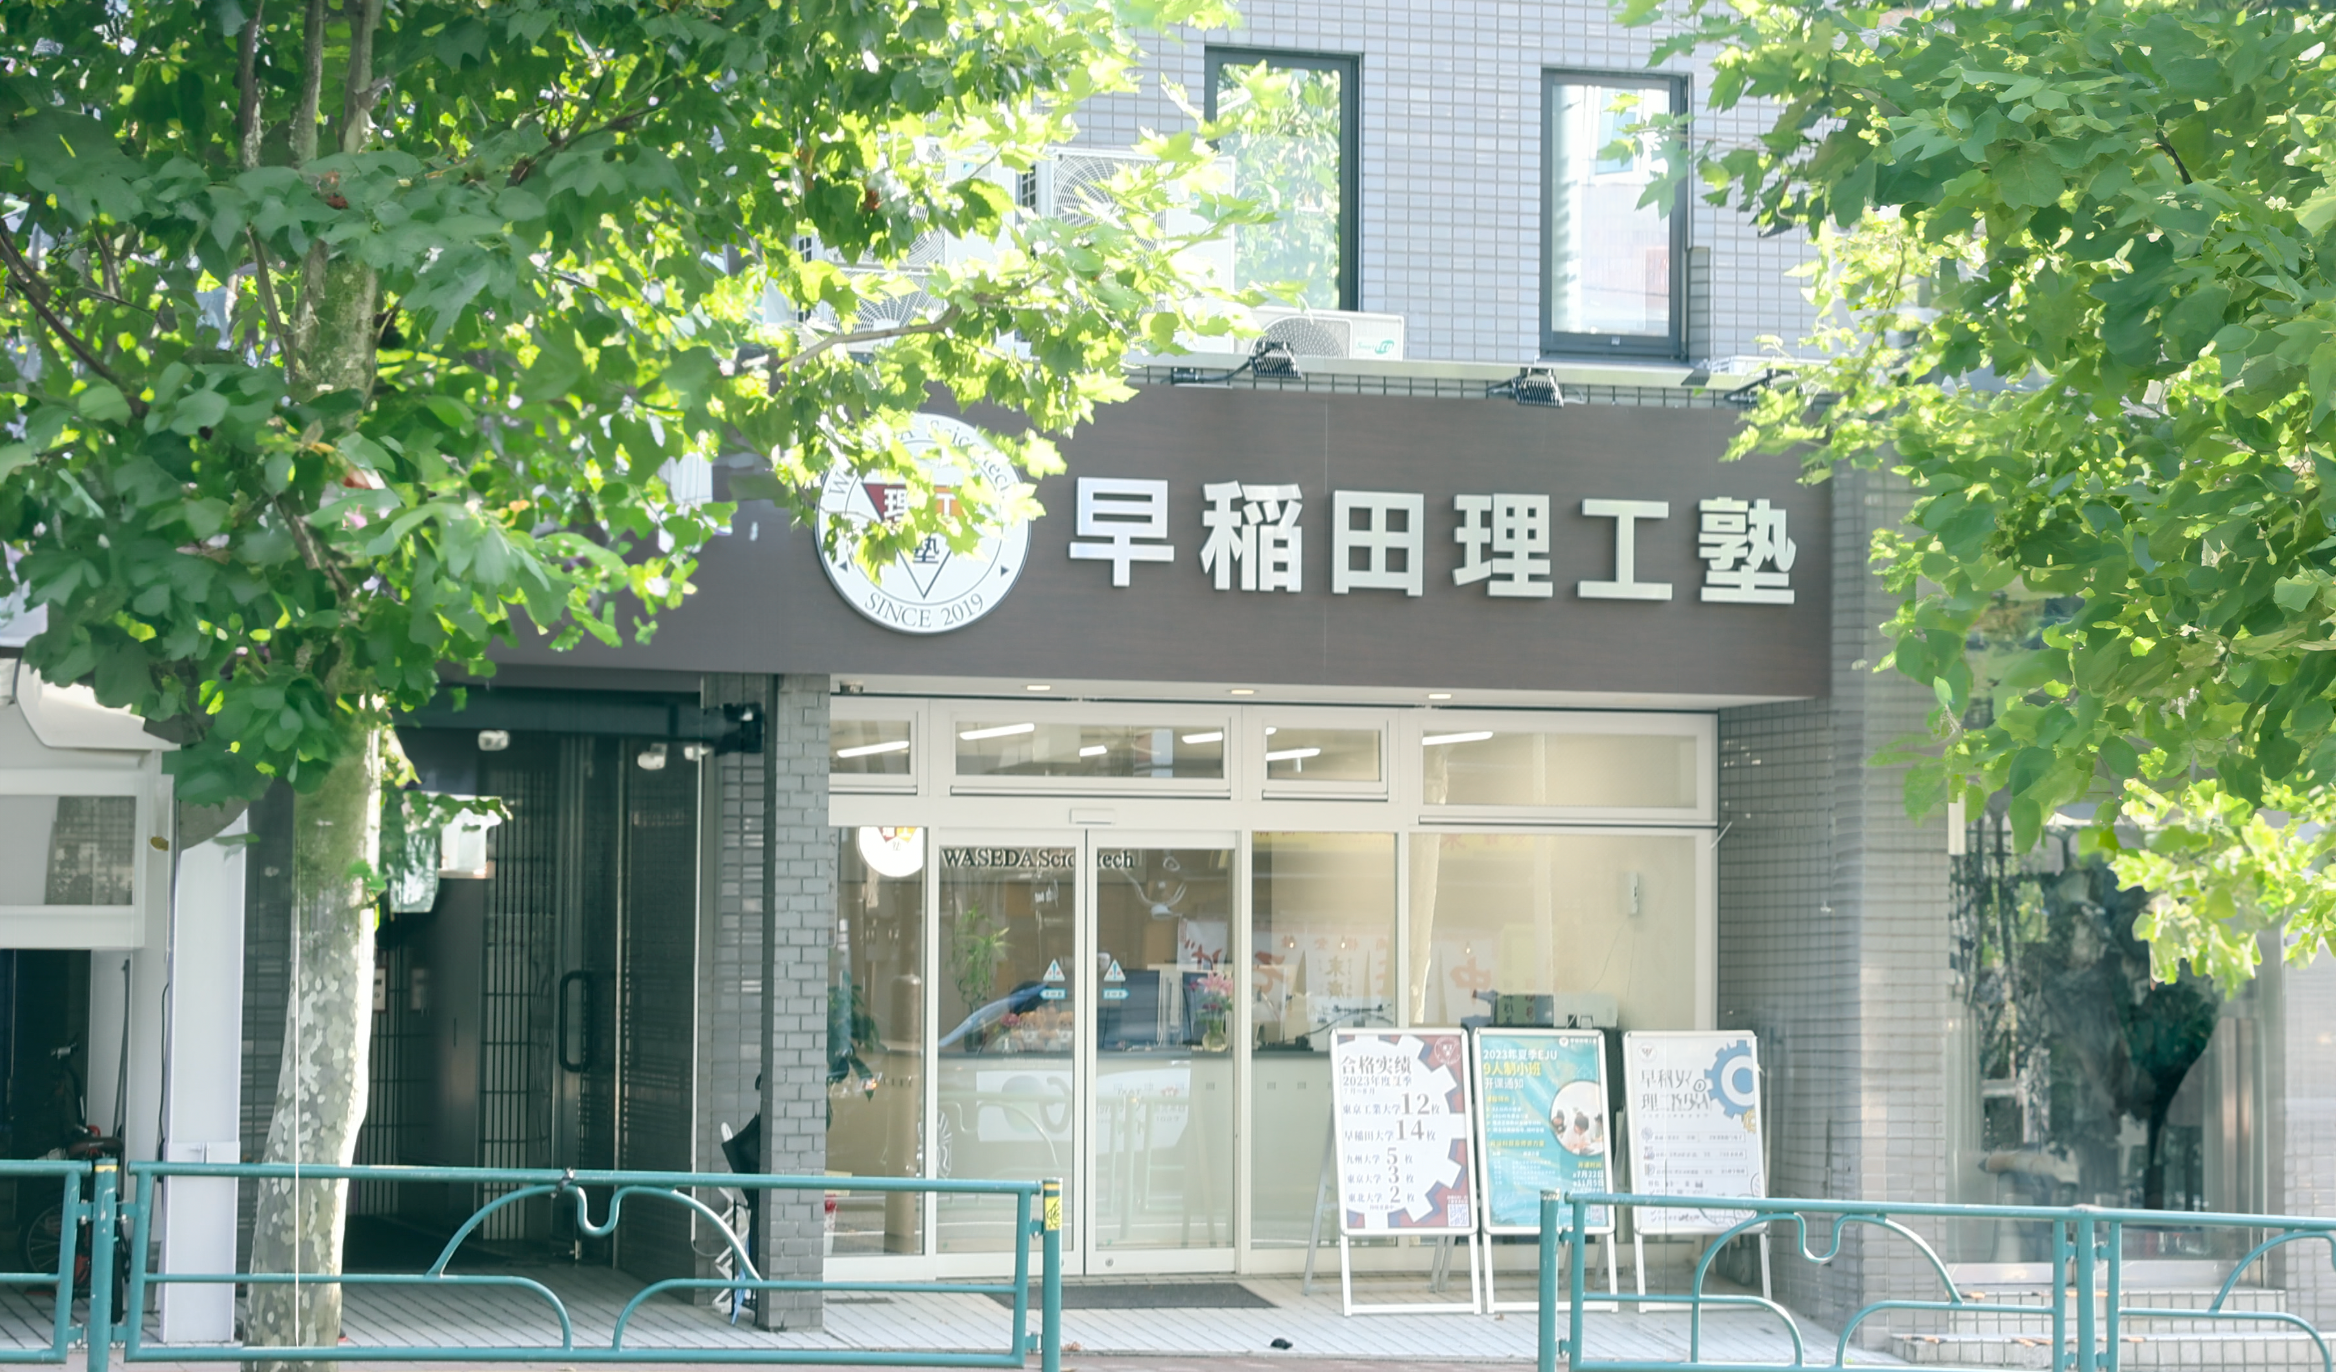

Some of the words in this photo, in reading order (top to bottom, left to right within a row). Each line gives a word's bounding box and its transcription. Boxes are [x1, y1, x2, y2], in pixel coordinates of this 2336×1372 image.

[1069, 476, 1797, 605] 早稲田理工塾
[865, 592, 932, 628] SINCE
[941, 593, 984, 626] 2019
[943, 849, 1034, 867] WASEDA
